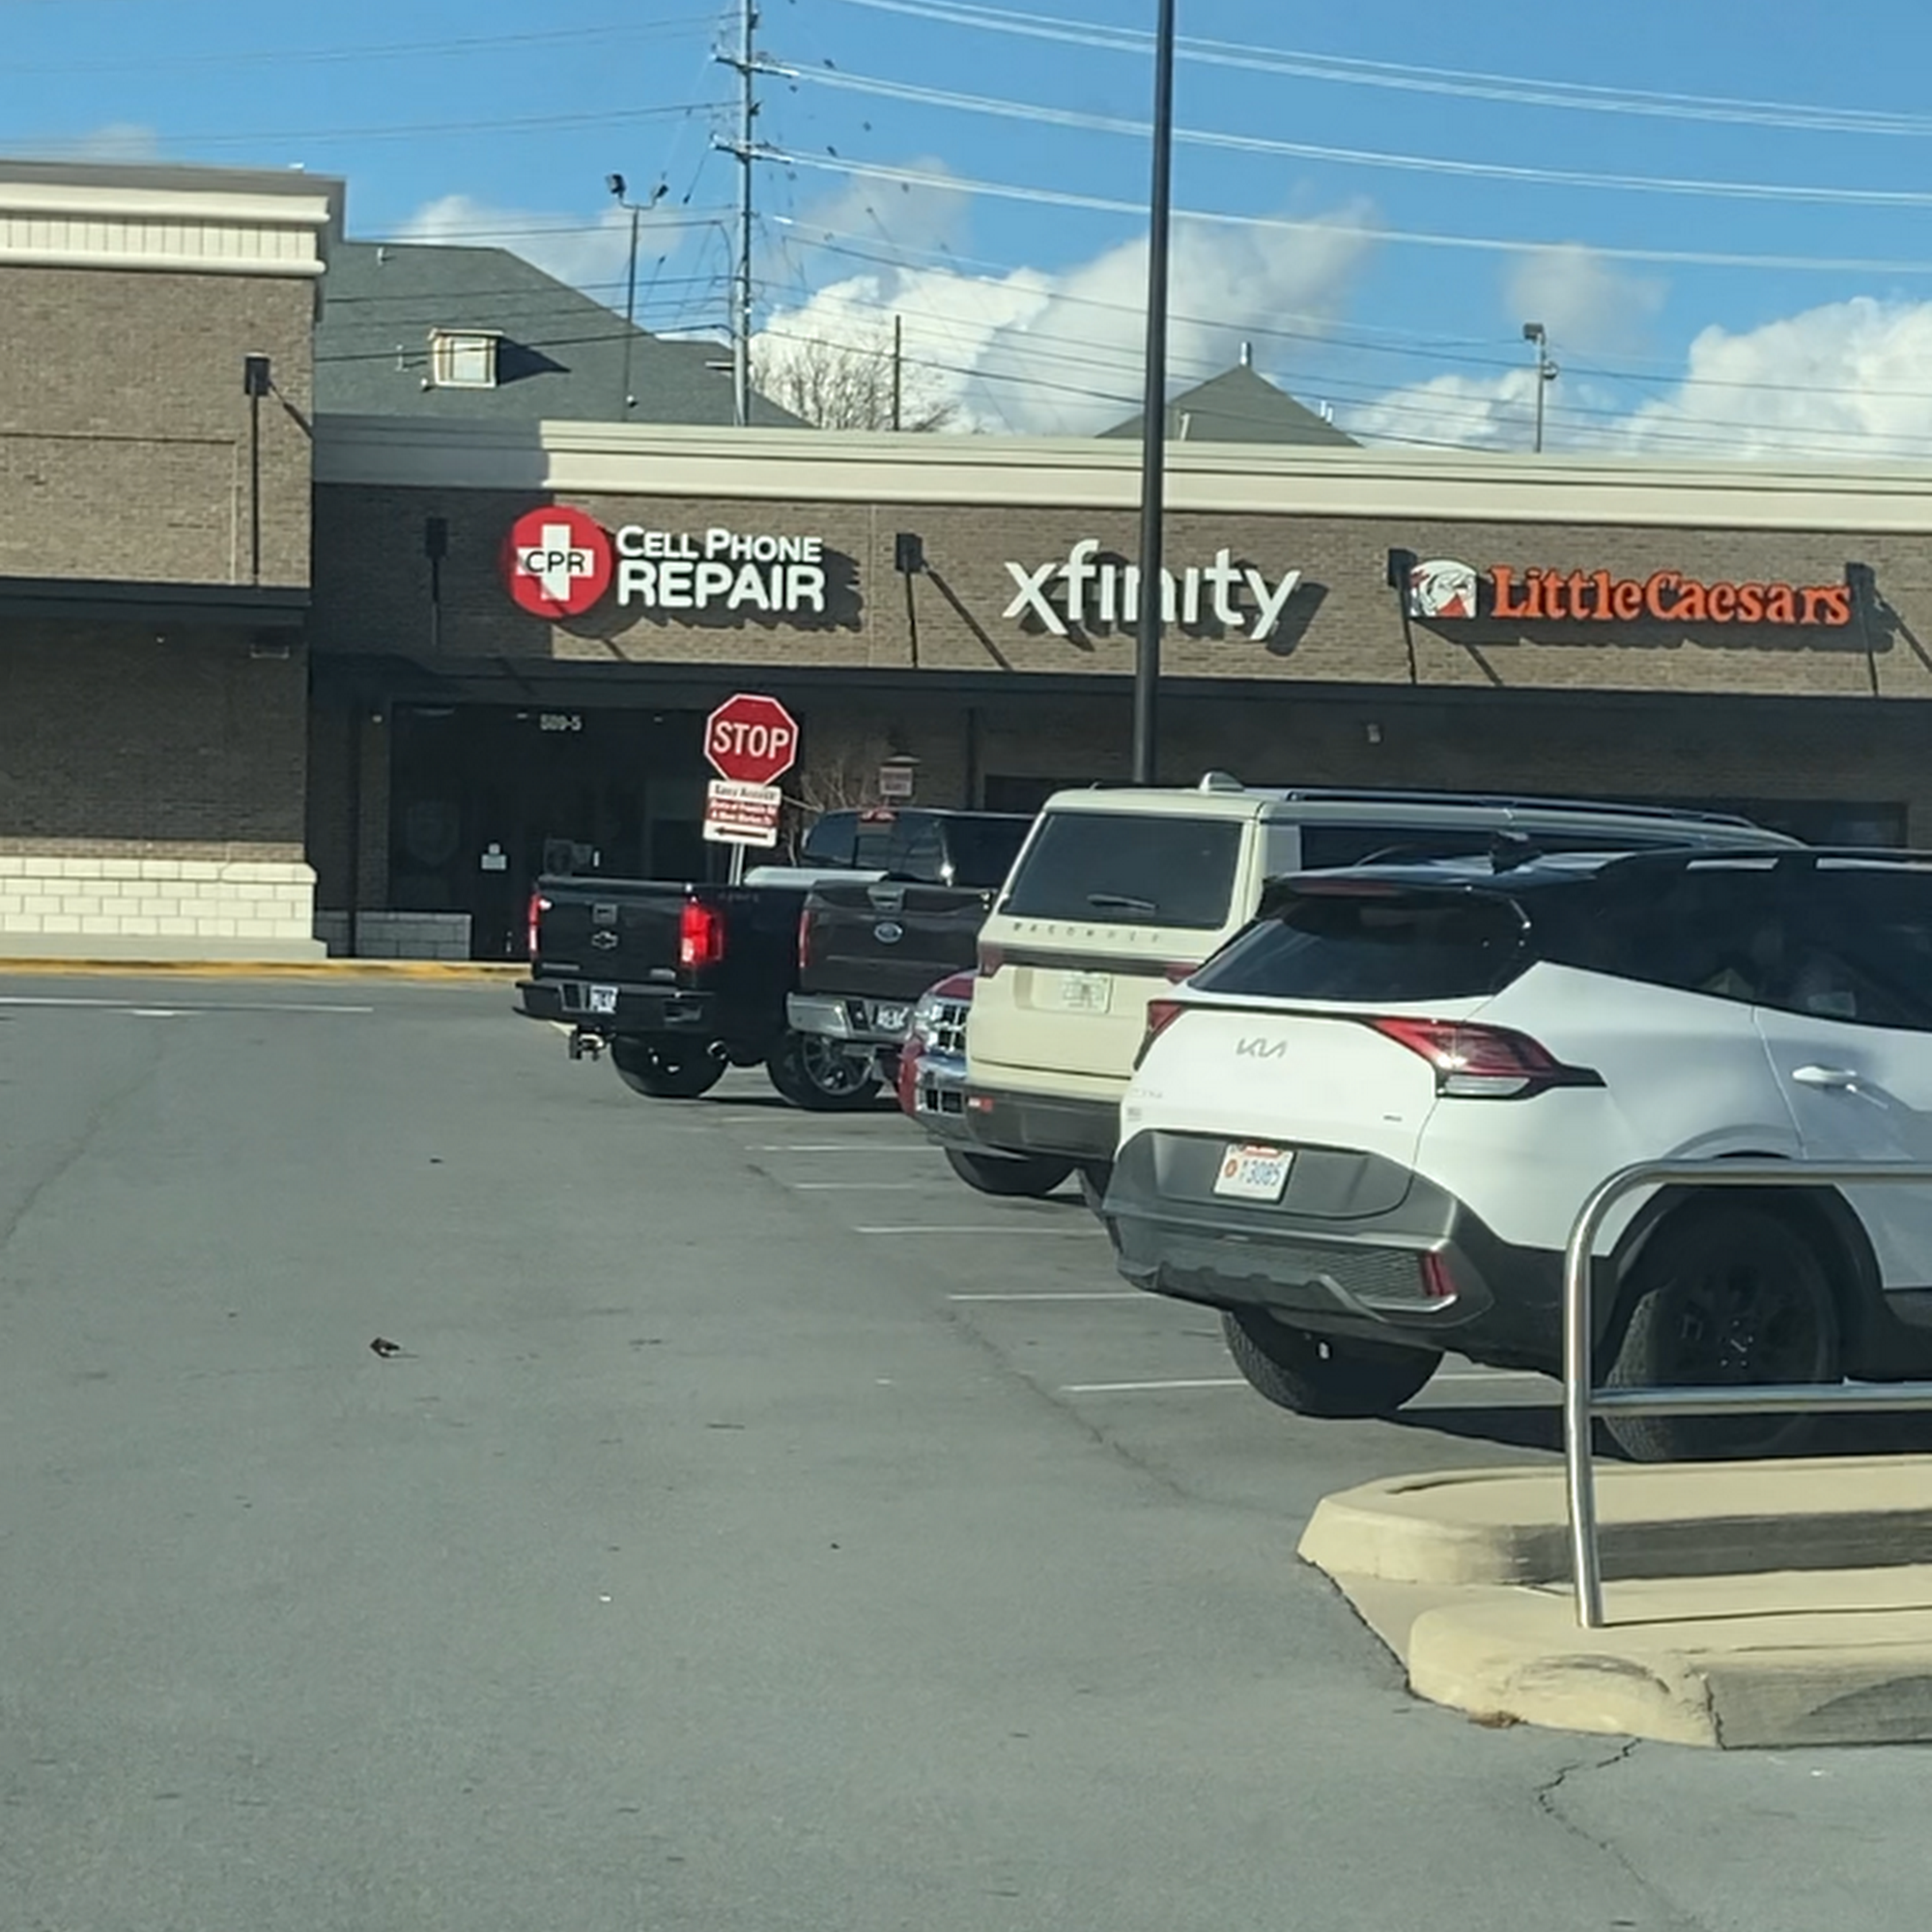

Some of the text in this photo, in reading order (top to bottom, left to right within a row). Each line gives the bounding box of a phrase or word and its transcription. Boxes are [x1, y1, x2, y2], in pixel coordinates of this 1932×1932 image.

[526, 550, 585, 574] CPR
[616, 526, 822, 562] CELL PHONE
[616, 559, 825, 611] REPAIR
[1002, 539, 1301, 639] xfinity
[712, 721, 790, 759] STOP
